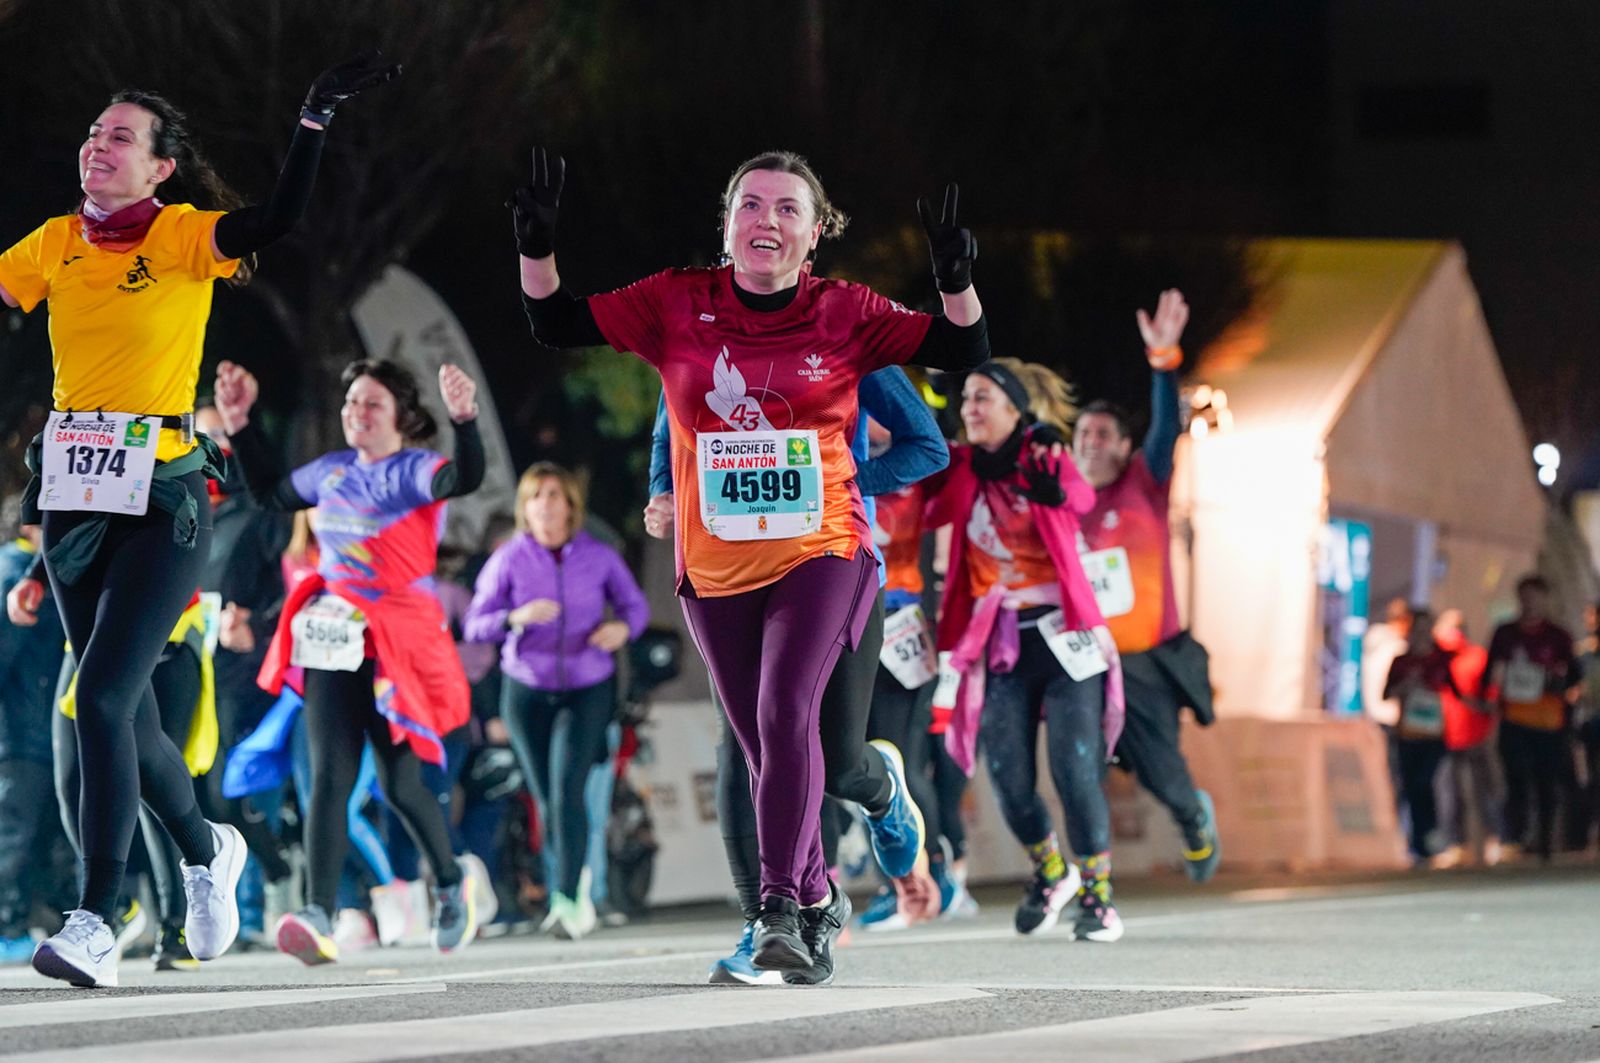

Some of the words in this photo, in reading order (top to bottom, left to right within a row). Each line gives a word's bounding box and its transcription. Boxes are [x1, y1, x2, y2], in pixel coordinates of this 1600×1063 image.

[729, 404, 760, 431] 43
[69, 423, 101, 434] NOCHE
[102, 423, 116, 433] DE
[55, 431, 76, 443] SAN
[76, 432, 115, 446] ANTÓN
[725, 444, 760, 455] NOCHE
[763, 443, 776, 453] DE
[66, 445, 127, 478] 1374
[712, 458, 735, 470] SAN
[738, 453, 777, 469] ANTÓN
[721, 469, 802, 503] 4599
